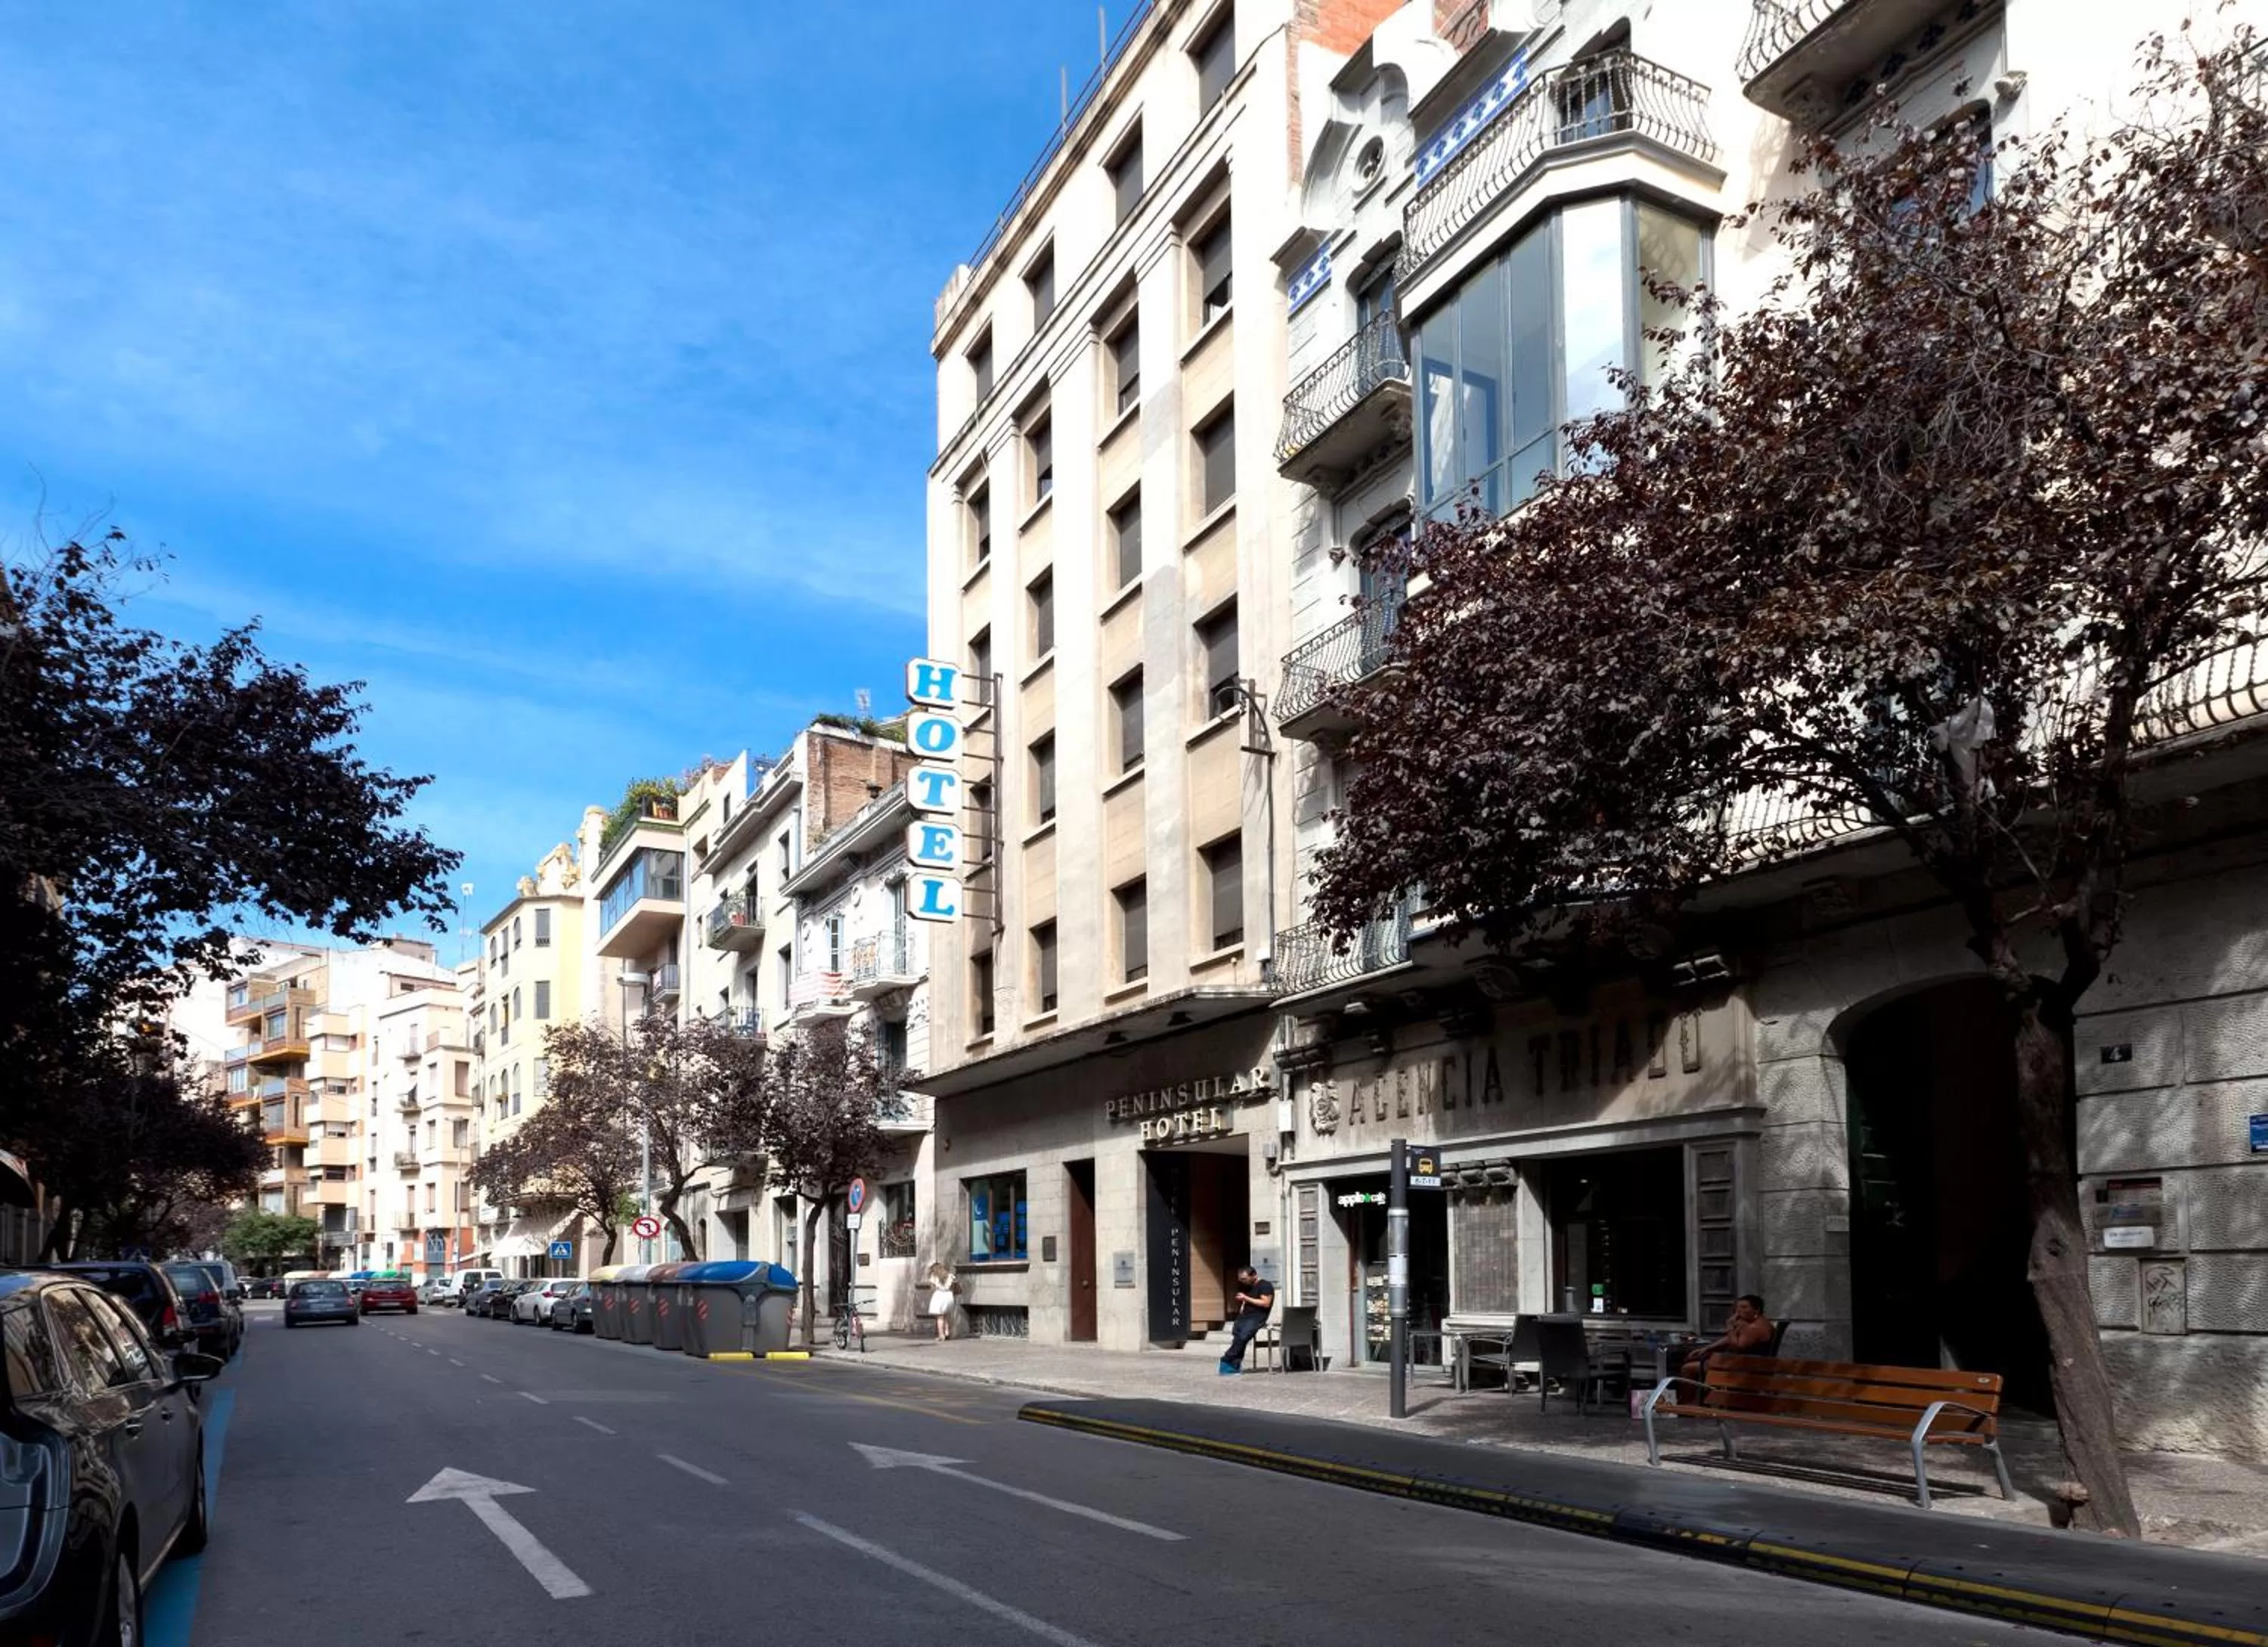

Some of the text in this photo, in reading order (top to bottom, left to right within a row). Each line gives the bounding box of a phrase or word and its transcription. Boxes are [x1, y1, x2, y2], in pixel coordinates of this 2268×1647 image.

[913, 664, 956, 916] HOTEL
[1349, 1047, 1504, 1126] AGENCIA
[2108, 1047, 2123, 1060] 4
[1105, 1066, 1267, 1120] PENINSULAR
[1139, 1108, 1222, 1140] HOTEL
[1170, 1227, 1181, 1326] PENINSULAR
